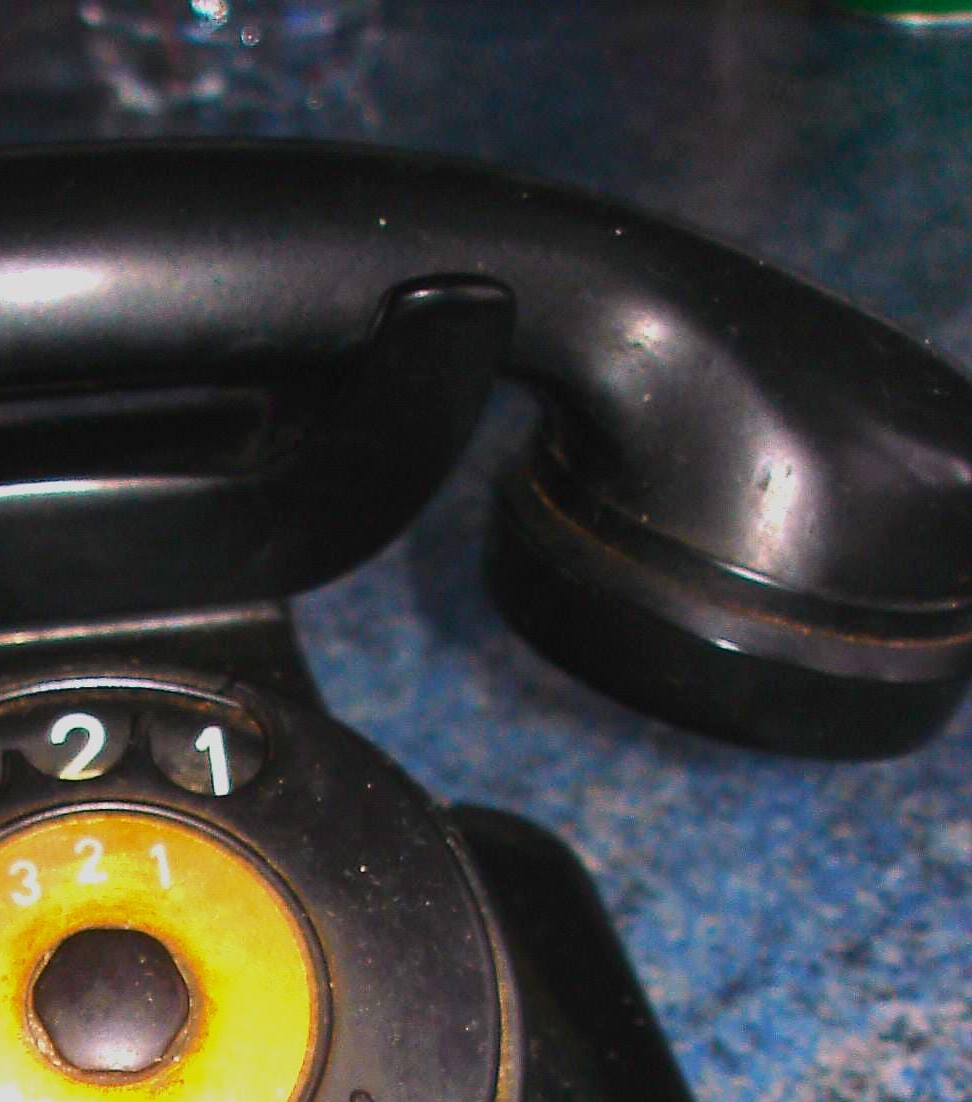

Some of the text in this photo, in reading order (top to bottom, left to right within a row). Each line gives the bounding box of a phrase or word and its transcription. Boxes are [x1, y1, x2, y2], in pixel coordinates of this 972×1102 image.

[48, 713, 105, 780] 2
[194, 727, 234, 796] 1
[8, 860, 42, 905] 3
[74, 838, 107, 884] 2
[149, 843, 171, 889] 1
